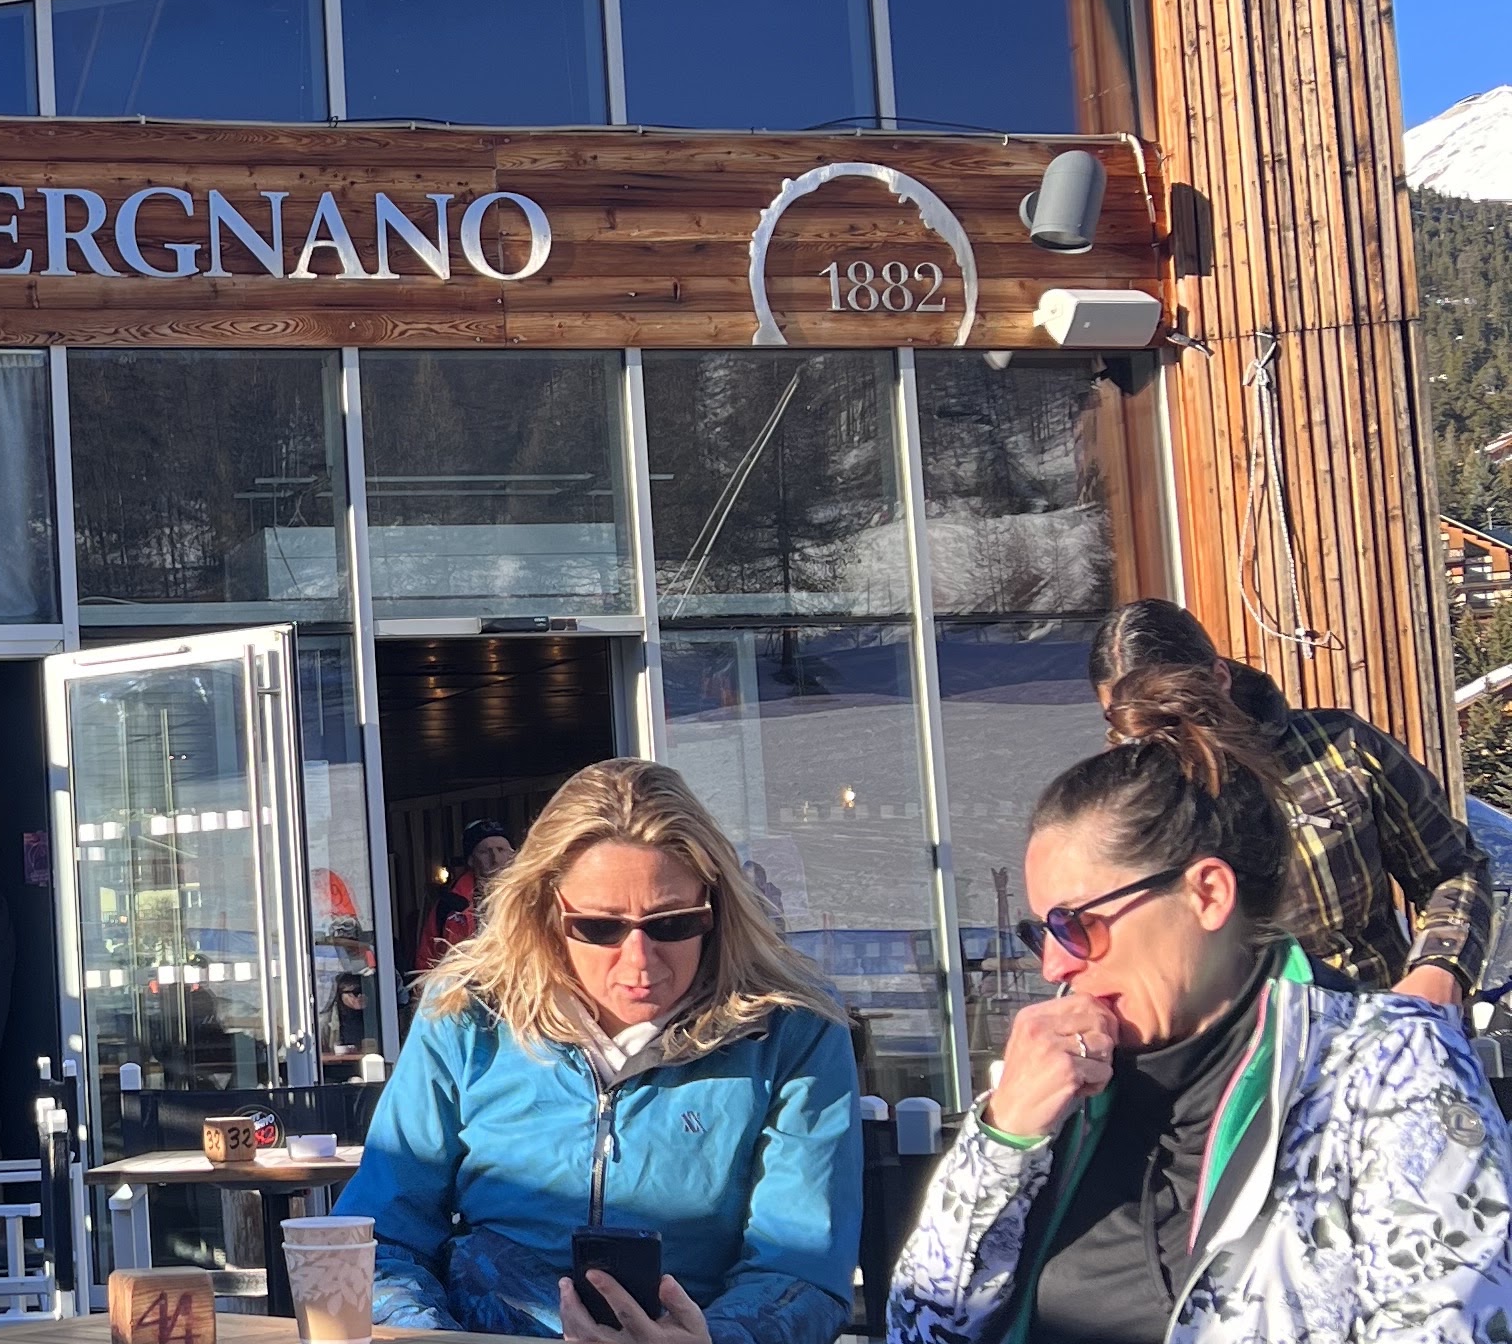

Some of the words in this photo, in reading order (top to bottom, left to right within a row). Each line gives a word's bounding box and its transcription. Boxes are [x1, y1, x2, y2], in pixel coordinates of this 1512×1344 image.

[819, 261, 947, 312] 1882
[206, 1129, 220, 1151] 32
[228, 1126, 253, 1150] 32
